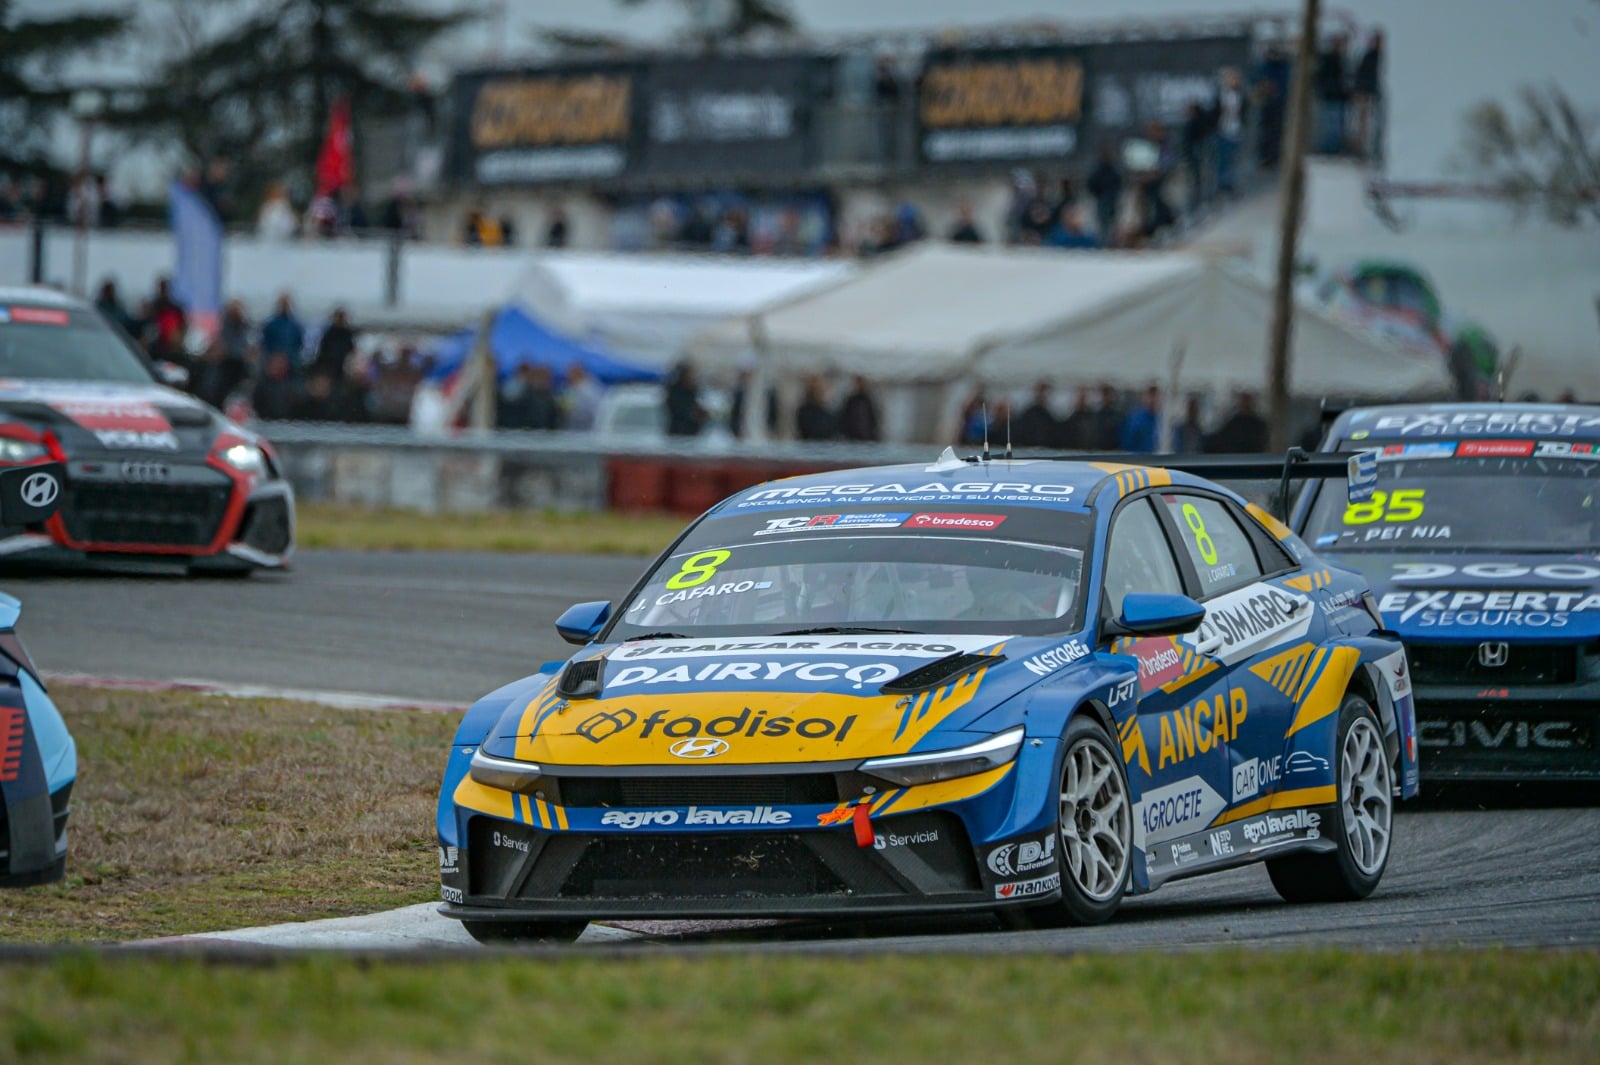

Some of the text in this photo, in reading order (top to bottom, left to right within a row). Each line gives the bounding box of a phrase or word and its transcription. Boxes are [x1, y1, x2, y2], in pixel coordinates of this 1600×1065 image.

[736, 497, 832, 508] EXCELENCIA
[837, 495, 857, 503] AL
[860, 494, 936, 502] SERVICIO
[938, 493, 962, 501] DE
[992, 494, 1071, 503] NEGOCIO
[746, 482, 1076, 502] MEGAAGRO
[1342, 488, 1426, 525] 85
[766, 514, 842, 530] TCR
[931, 516, 996, 528] bradesco
[1182, 503, 1218, 566] 8
[665, 549, 732, 591] 8
[630, 580, 756, 613] J. CAFARO
[1211, 590, 1297, 646] SIMAGRO
[1418, 611, 1571, 627] SEGUROS
[658, 641, 958, 654] RAIZAR AGRO
[1145, 647, 1180, 676] bradesco
[605, 661, 900, 690] DAIRYCO
[639, 707, 858, 742] fadisol
[1158, 686, 1248, 770] ANCAP
[1418, 720, 1573, 749] CIVIC
[1235, 765, 1256, 796] CAR
[601, 805, 793, 829] agro lavalle
[1143, 788, 1202, 834] AGROCETE
[889, 829, 939, 847] Servicial
[1243, 820, 1268, 844] agro
[1266, 808, 1321, 834] lavalle
